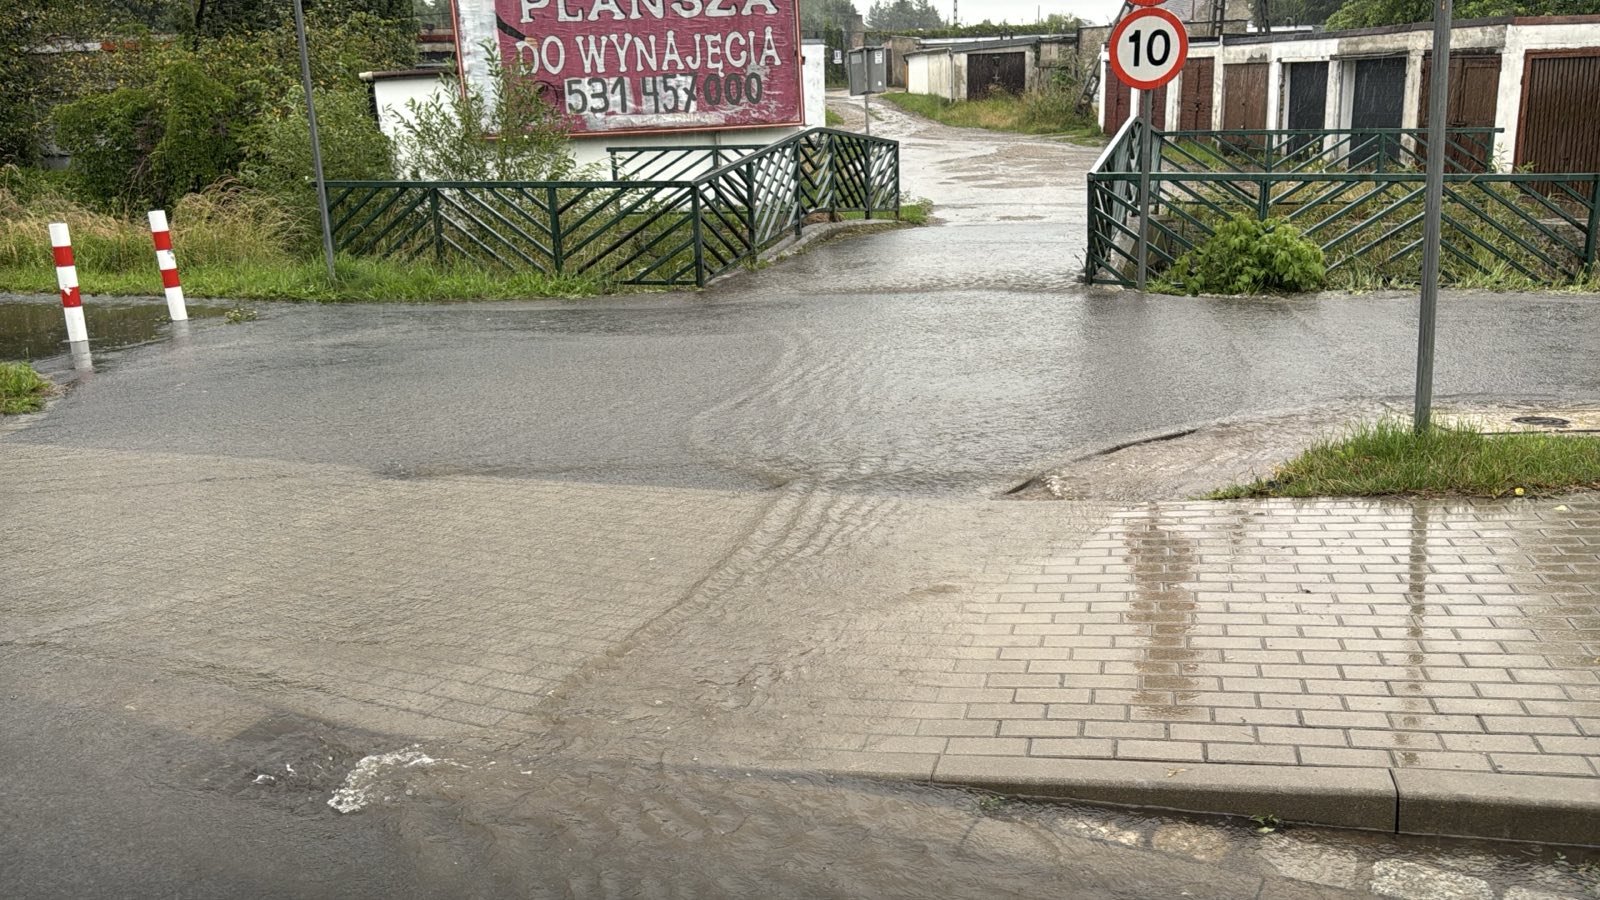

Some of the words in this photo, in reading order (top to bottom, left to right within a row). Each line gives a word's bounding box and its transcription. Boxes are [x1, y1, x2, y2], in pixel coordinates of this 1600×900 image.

[515, 36, 565, 75] DO
[575, 26, 781, 77] WYNAJĘCIA
[1129, 29, 1171, 67] 10
[566, 76, 627, 113] 531
[641, 73, 698, 113] 457
[704, 72, 763, 105] 000
